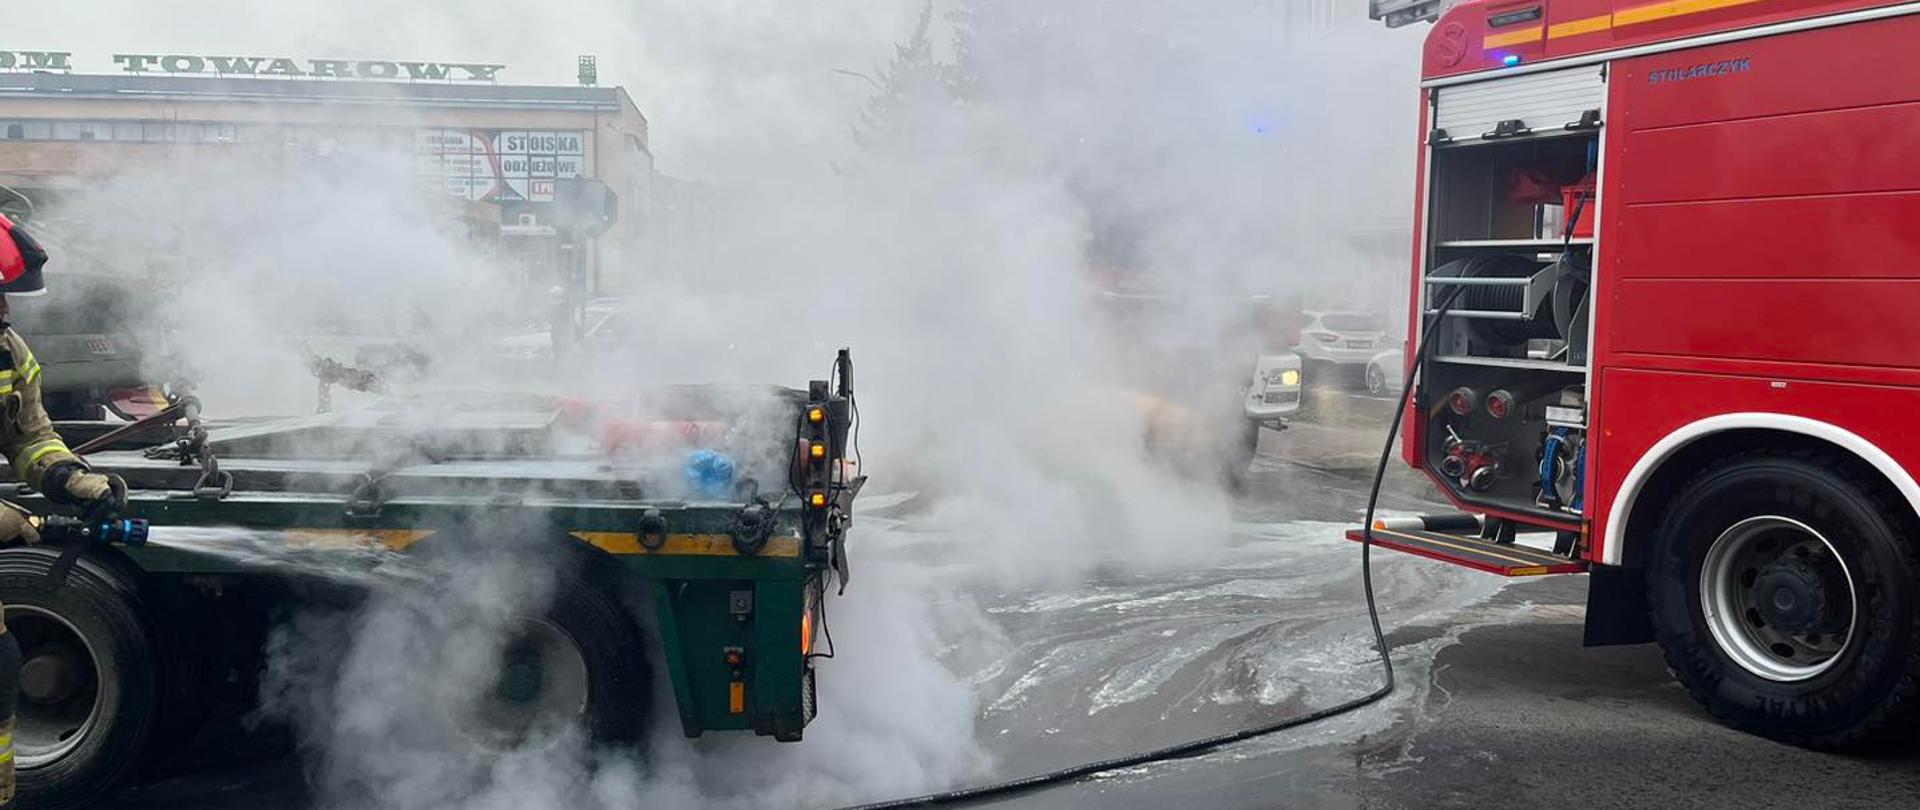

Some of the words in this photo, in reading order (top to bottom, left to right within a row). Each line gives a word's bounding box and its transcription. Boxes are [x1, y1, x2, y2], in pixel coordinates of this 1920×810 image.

[113, 54, 506, 80] TOWAROWY
[1648, 57, 1751, 84] STOLARCZYK
[507, 135, 579, 152] STOISKA
